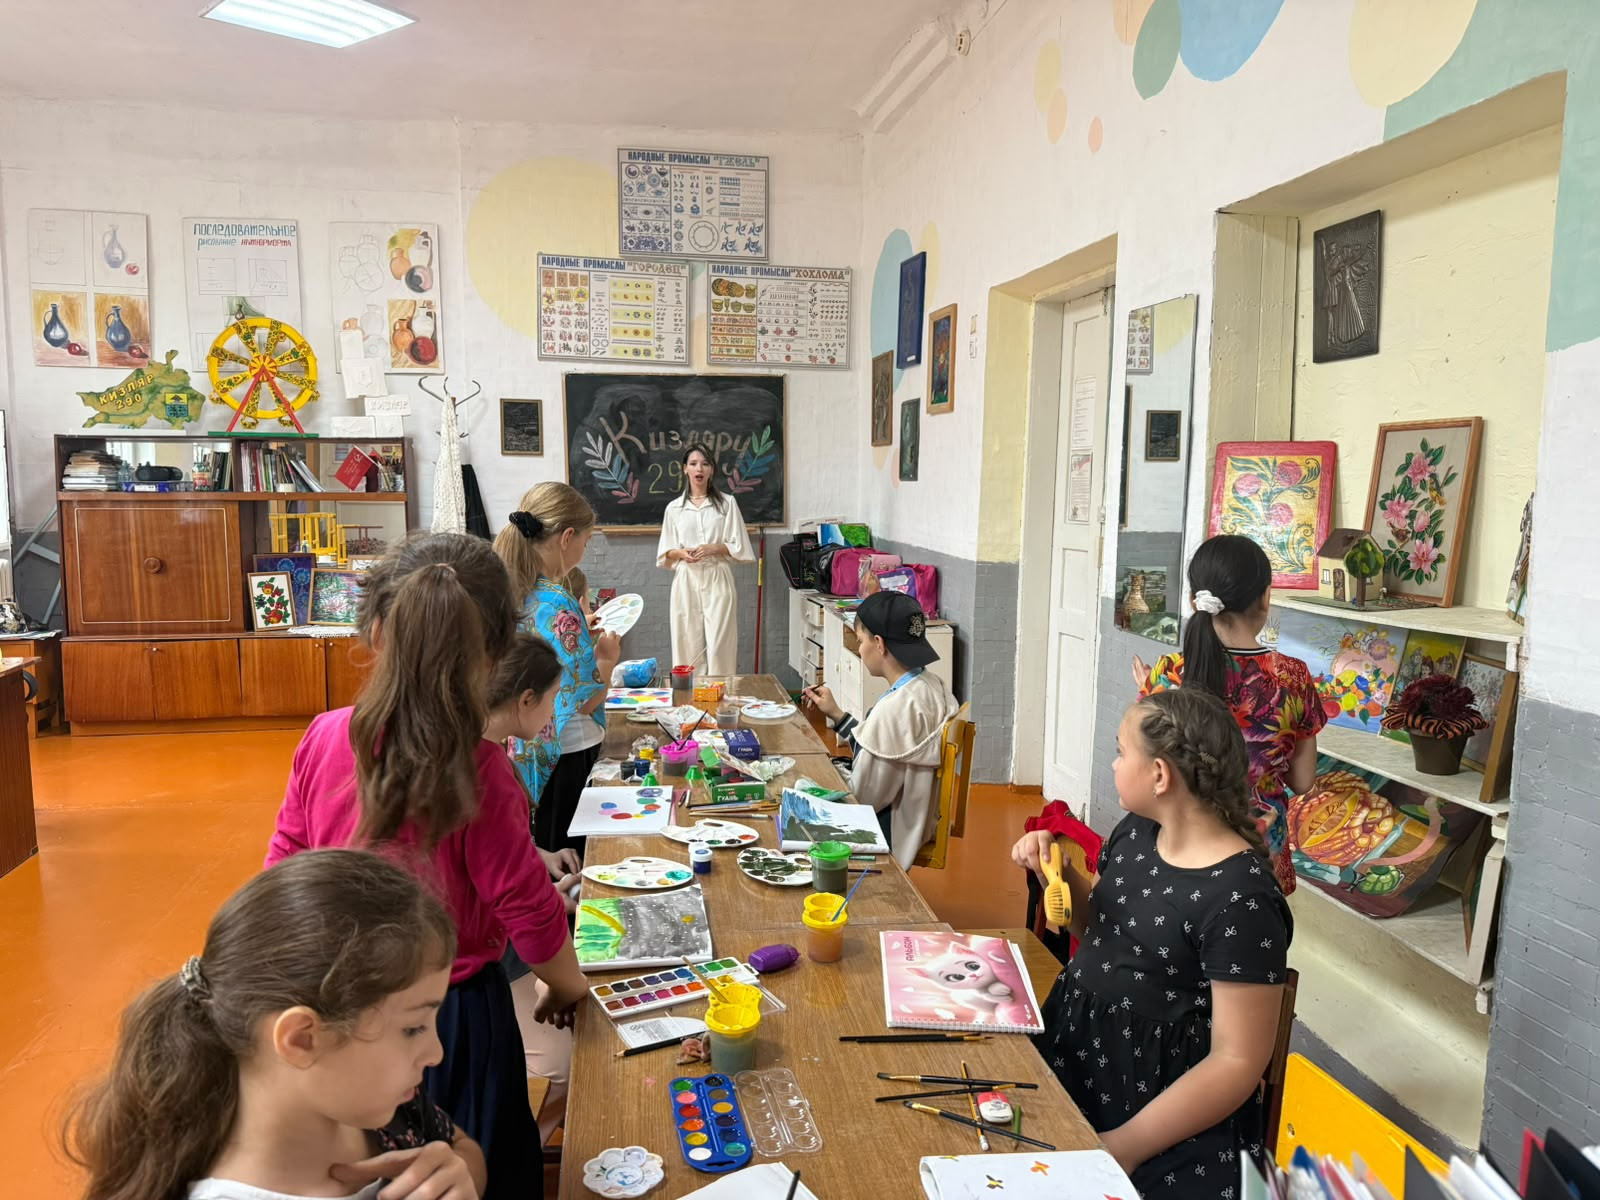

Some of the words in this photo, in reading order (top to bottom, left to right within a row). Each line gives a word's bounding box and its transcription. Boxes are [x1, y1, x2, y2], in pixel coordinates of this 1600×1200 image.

[628, 151, 665, 163] НАРОДНЫЕ
[668, 154, 711, 165] ПРОМЫСЛЫ
[541, 256, 580, 268] НАРОДНЫЕ
[583, 259, 626, 271] ПРОМЫСЛЫ
[711, 264, 748, 276] НАРОДНЫЕ
[750, 266, 791, 277] ПРОМЫСЛЫ
[99, 374, 154, 406] КИЗЛЯР
[115, 393, 142, 411] 290
[903, 936, 914, 961] АЛЬБОМ
